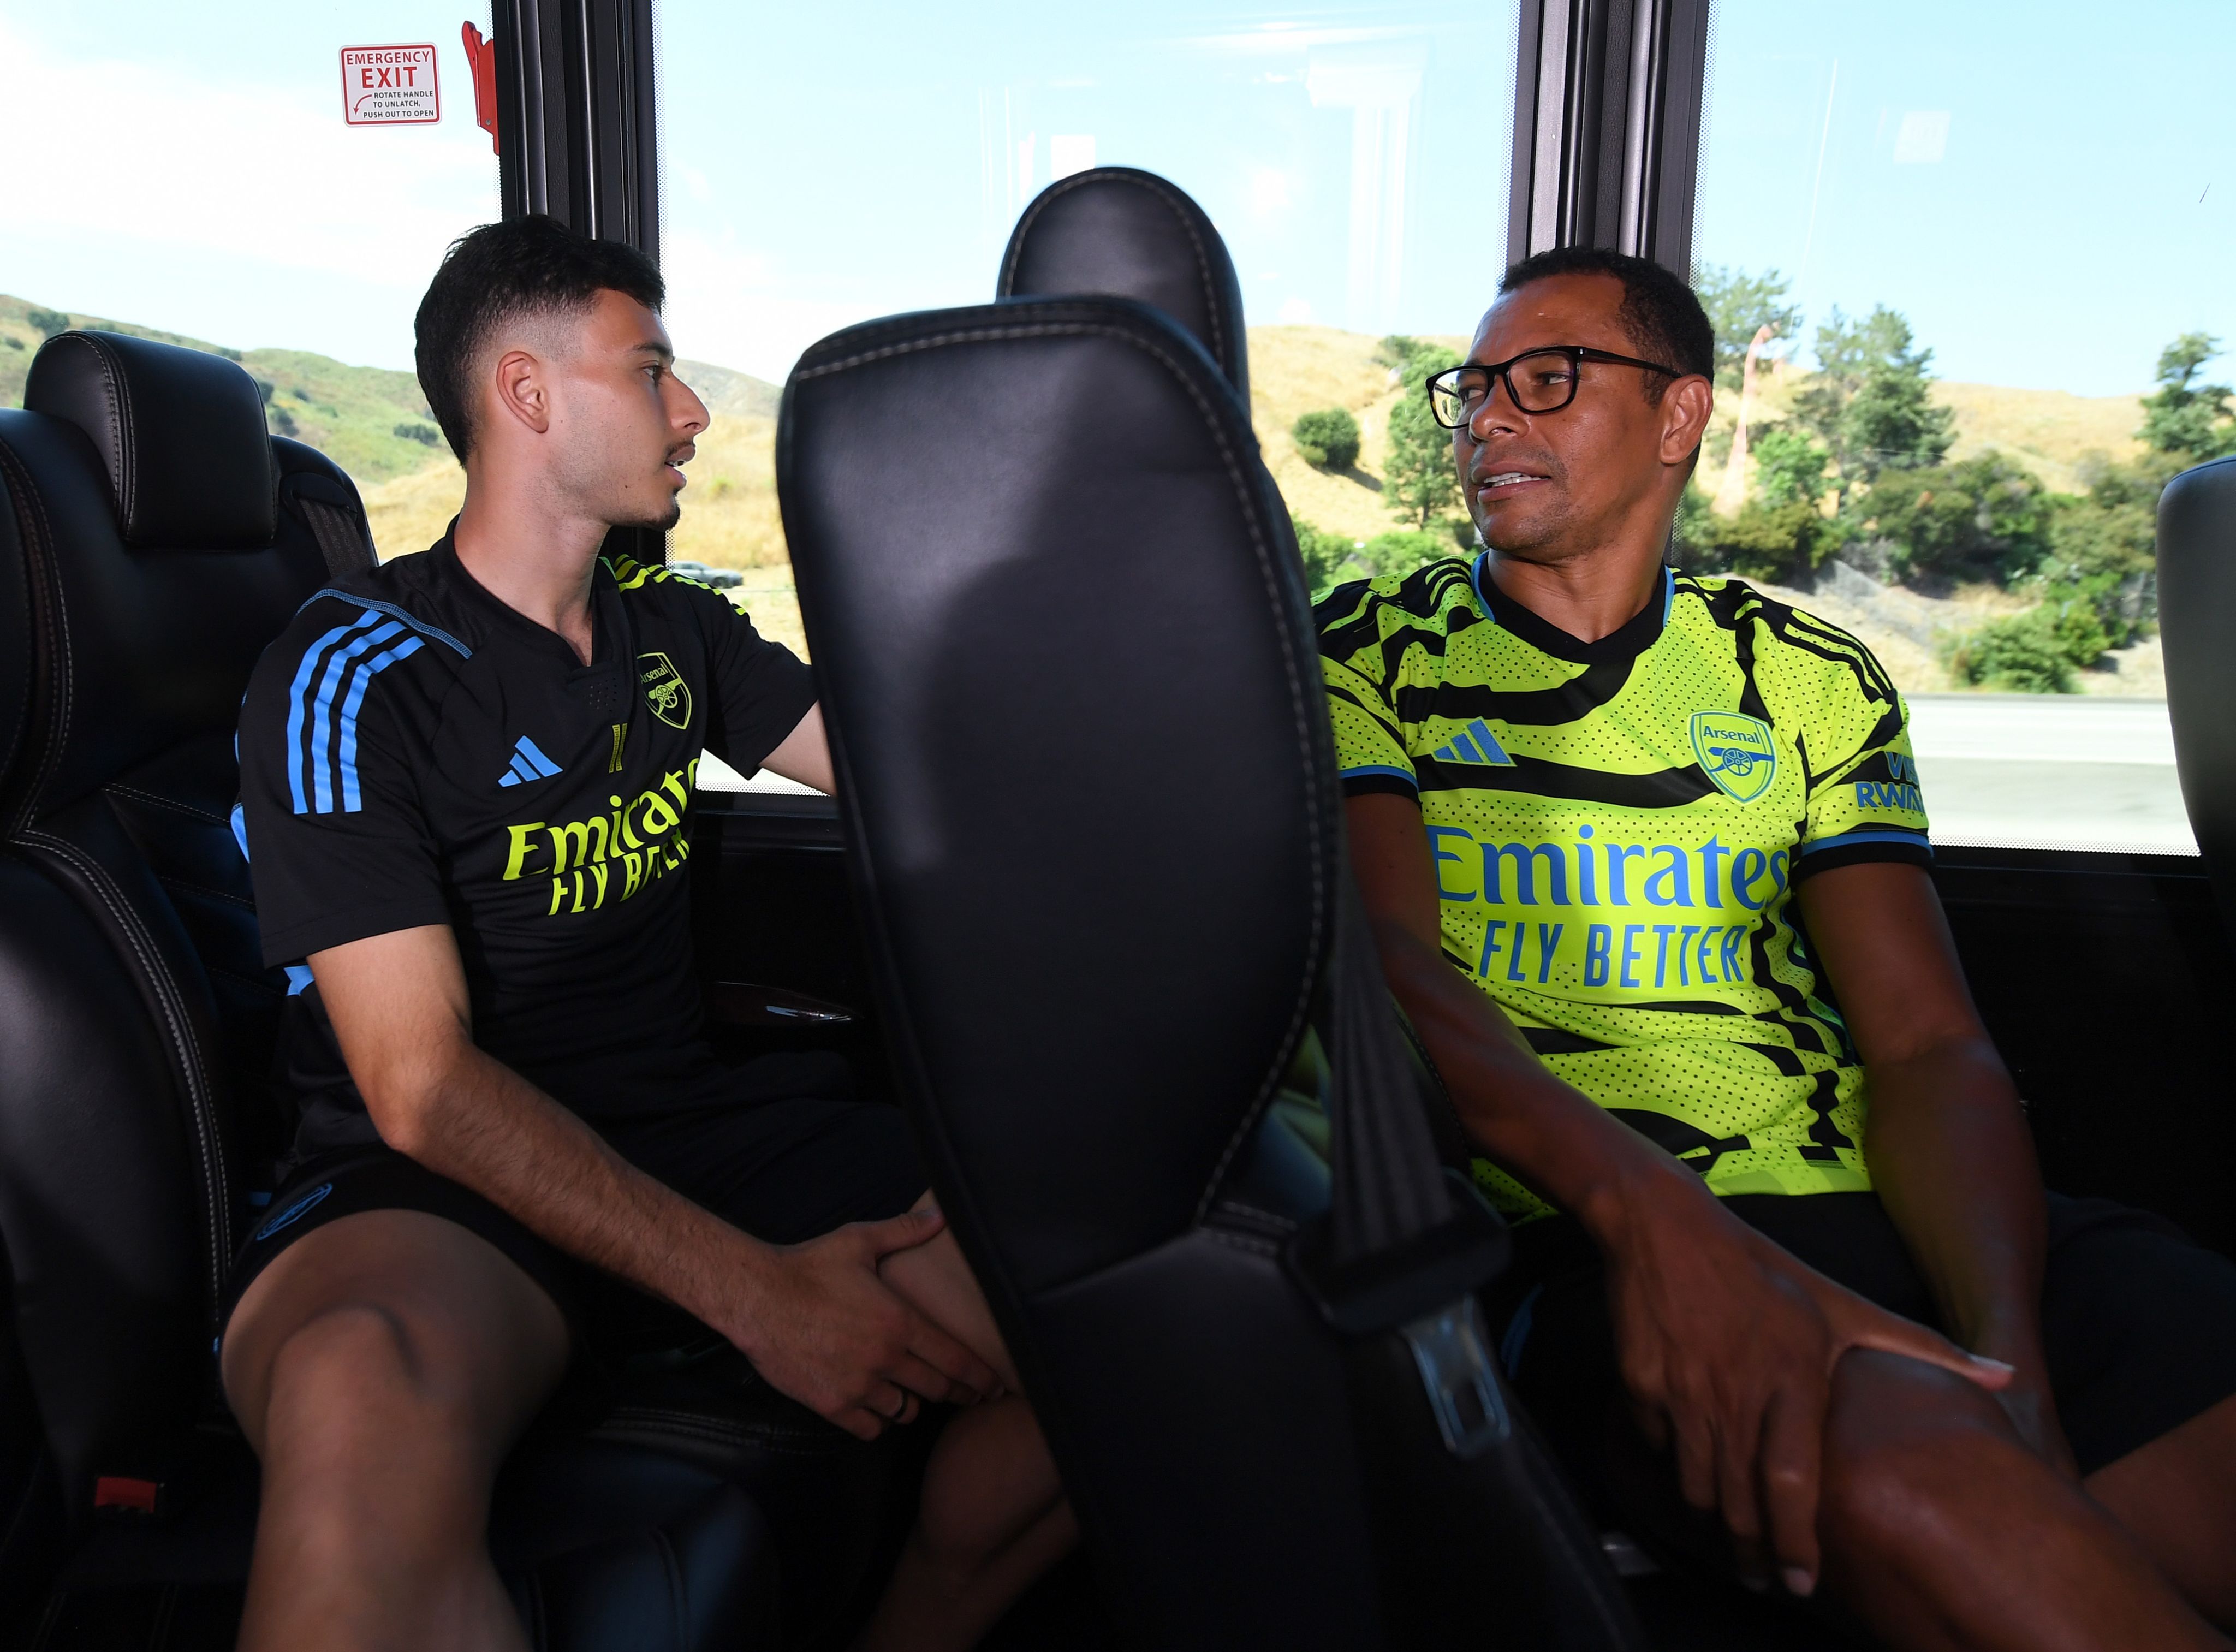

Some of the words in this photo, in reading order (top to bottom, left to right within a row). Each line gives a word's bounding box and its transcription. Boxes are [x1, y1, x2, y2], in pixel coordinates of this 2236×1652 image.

[347, 51, 430, 65] EMERGENCY
[361, 66, 417, 88] EXIT
[639, 663, 669, 684] Arsenal
[1703, 725, 1761, 745] Arsenal
[1854, 781, 1925, 813] RWA
[1425, 824, 1788, 911] Emirates
[548, 863, 608, 916] FLY
[1478, 920, 1563, 984] FLY
[1583, 924, 1747, 988] BETTER
